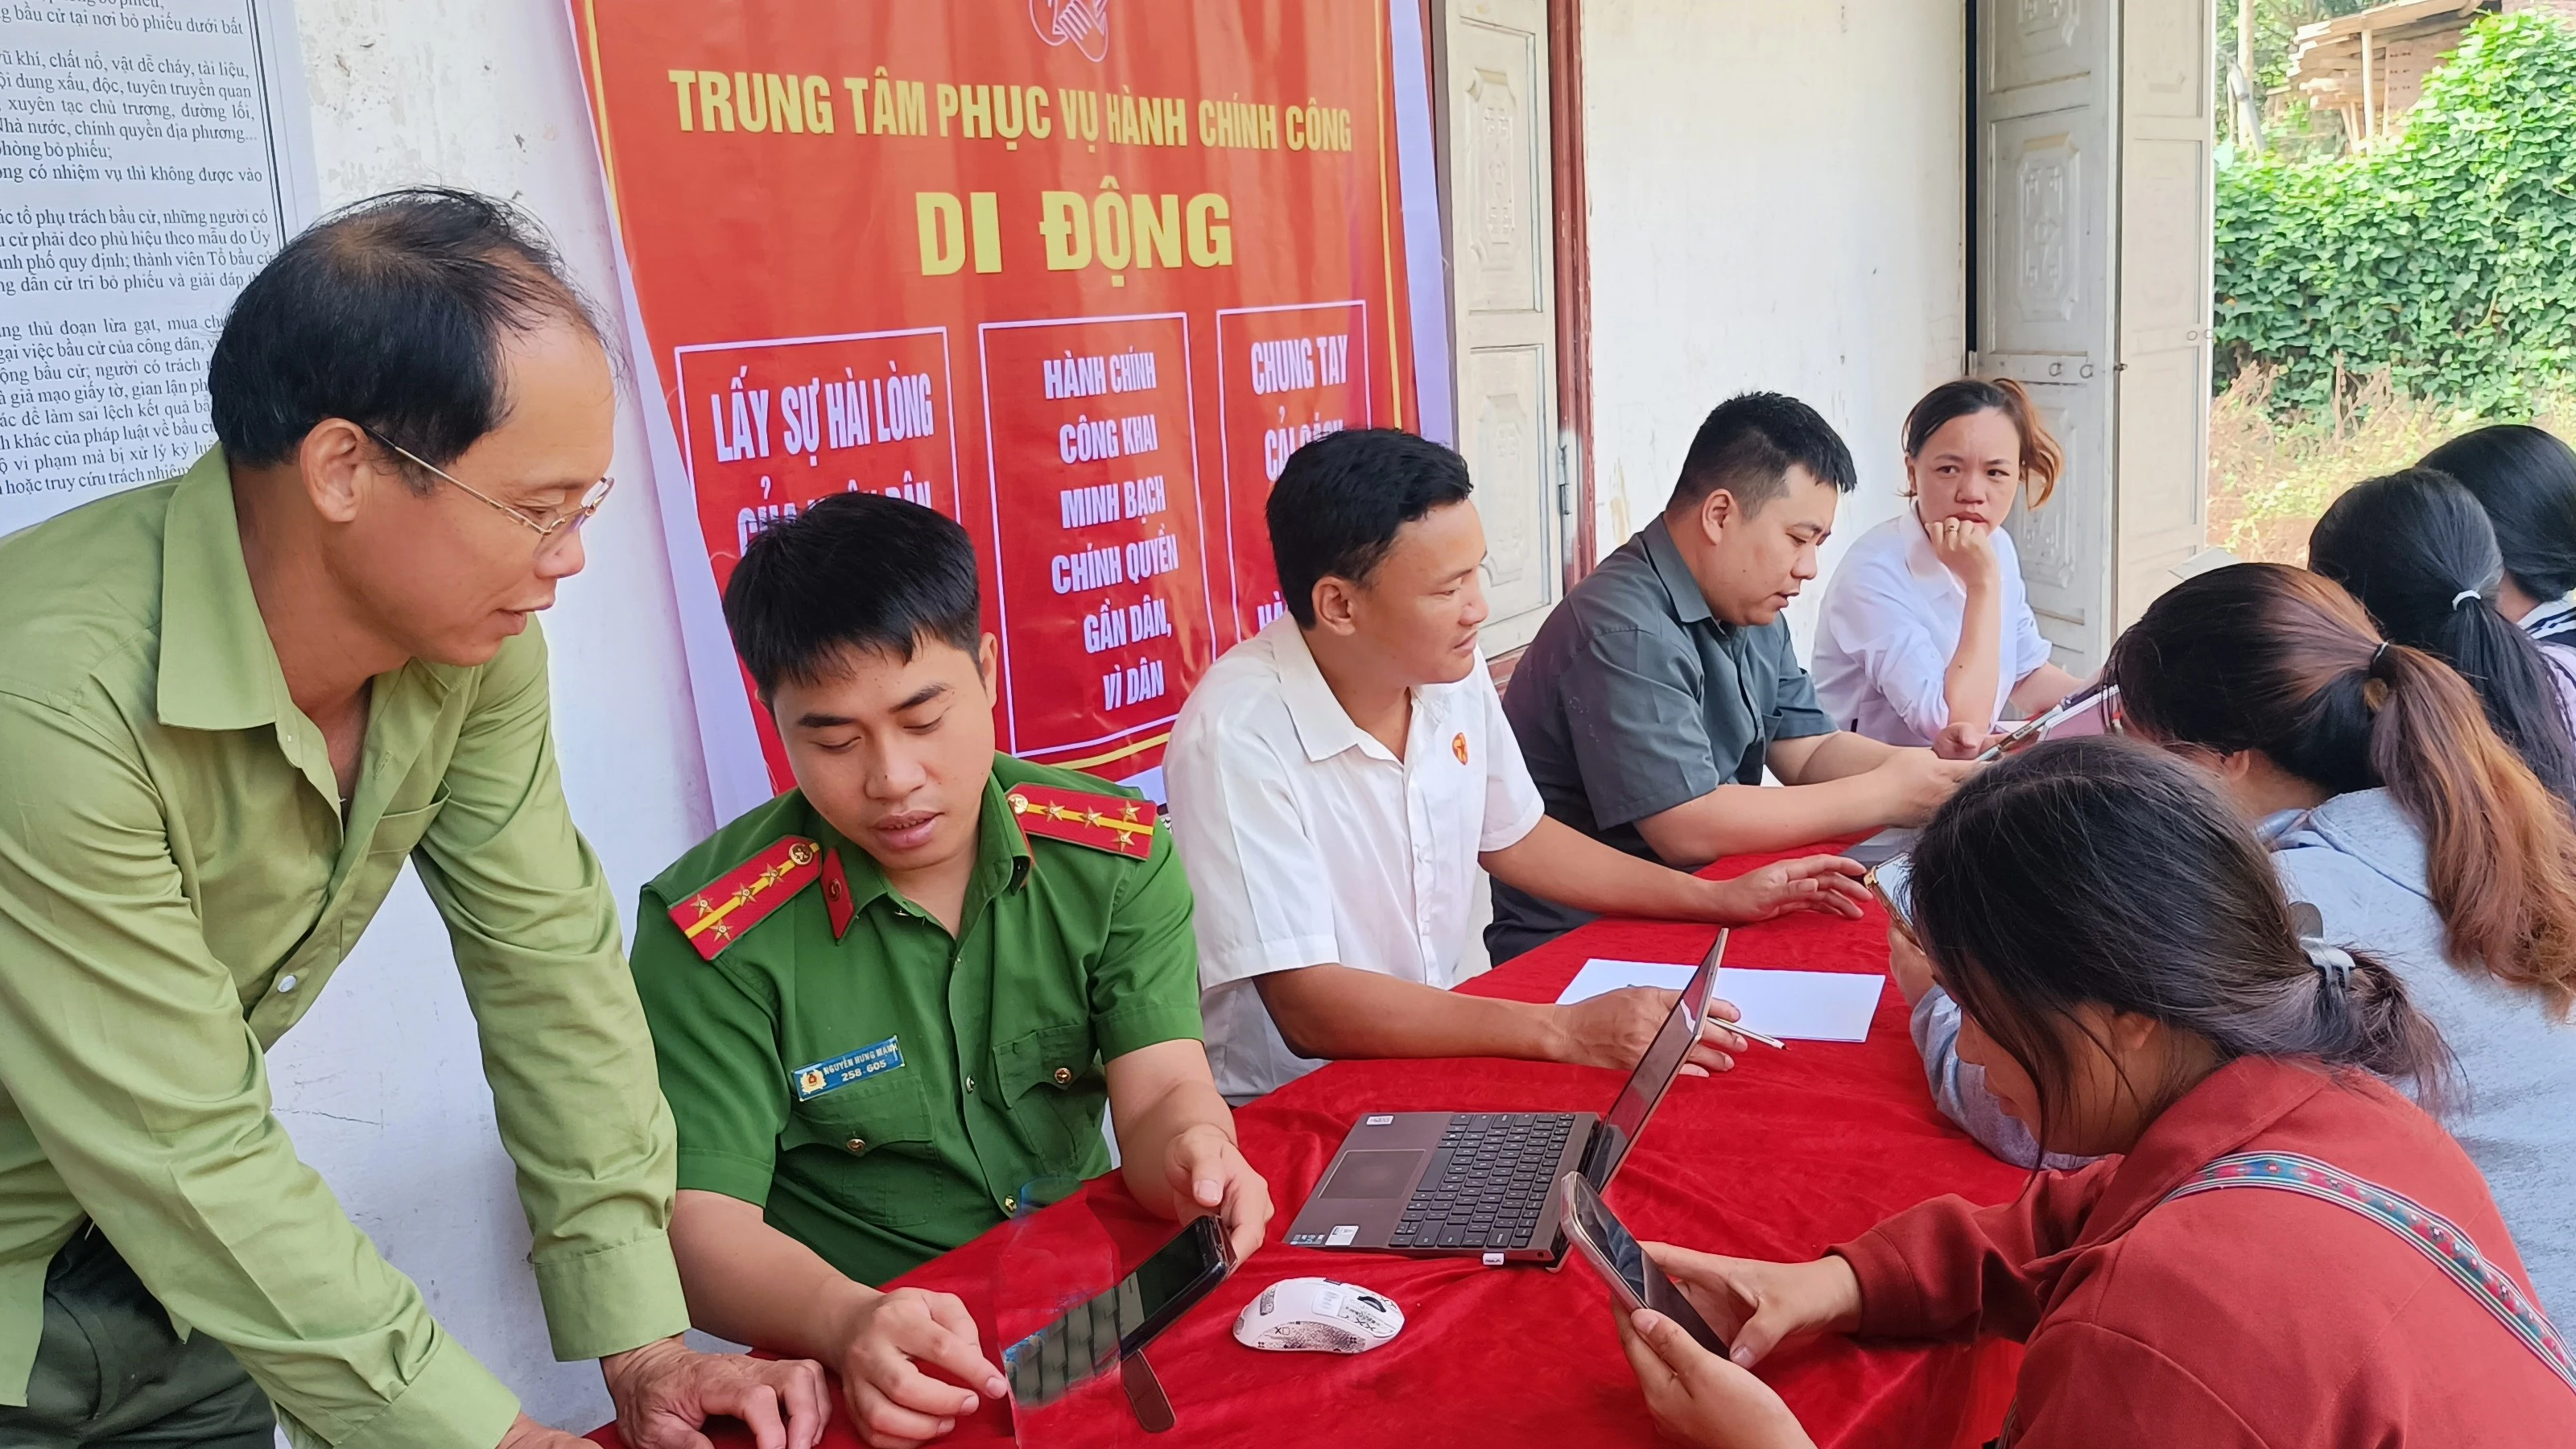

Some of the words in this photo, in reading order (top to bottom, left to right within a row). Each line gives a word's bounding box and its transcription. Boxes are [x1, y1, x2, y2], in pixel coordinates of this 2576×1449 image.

[668, 69, 835, 134] TRUNG
[844, 66, 928, 136] TÂM
[936, 83, 1051, 151] PHỤC
[1059, 89, 1100, 153] VỤ
[1106, 85, 1188, 147] HÀNH
[1198, 93, 1278, 150] CHÍNH
[1286, 97, 1352, 152] CÔNG
[0, 140, 42, 160] hòng
[916, 192, 1003, 276] DI
[1039, 175, 1233, 287] ĐỘNG
[1043, 350, 1107, 399] HÀNH
[1109, 345, 1157, 393] CHÍNH
[1251, 338, 1315, 394] CHUNG
[1316, 335, 1348, 386] TAY
[711, 365, 770, 462] LẤY
[781, 378, 819, 467] SỰ
[825, 367, 870, 448] HÀI
[873, 361, 934, 443] LÒNG
[1059, 415, 1119, 464] CÔNG
[1121, 415, 1158, 455] KHAI
[1060, 483, 1120, 528] MINH
[1124, 476, 1166, 523] BẠCH
[1051, 543, 1123, 594] CHÍNH
[1125, 523, 1179, 584] QUYỀN
[1084, 598, 1126, 654] GẦN
[1129, 594, 1171, 642] DÂN,
[1103, 664, 1122, 711] VÌ
[1127, 657, 1164, 705] DÂN
